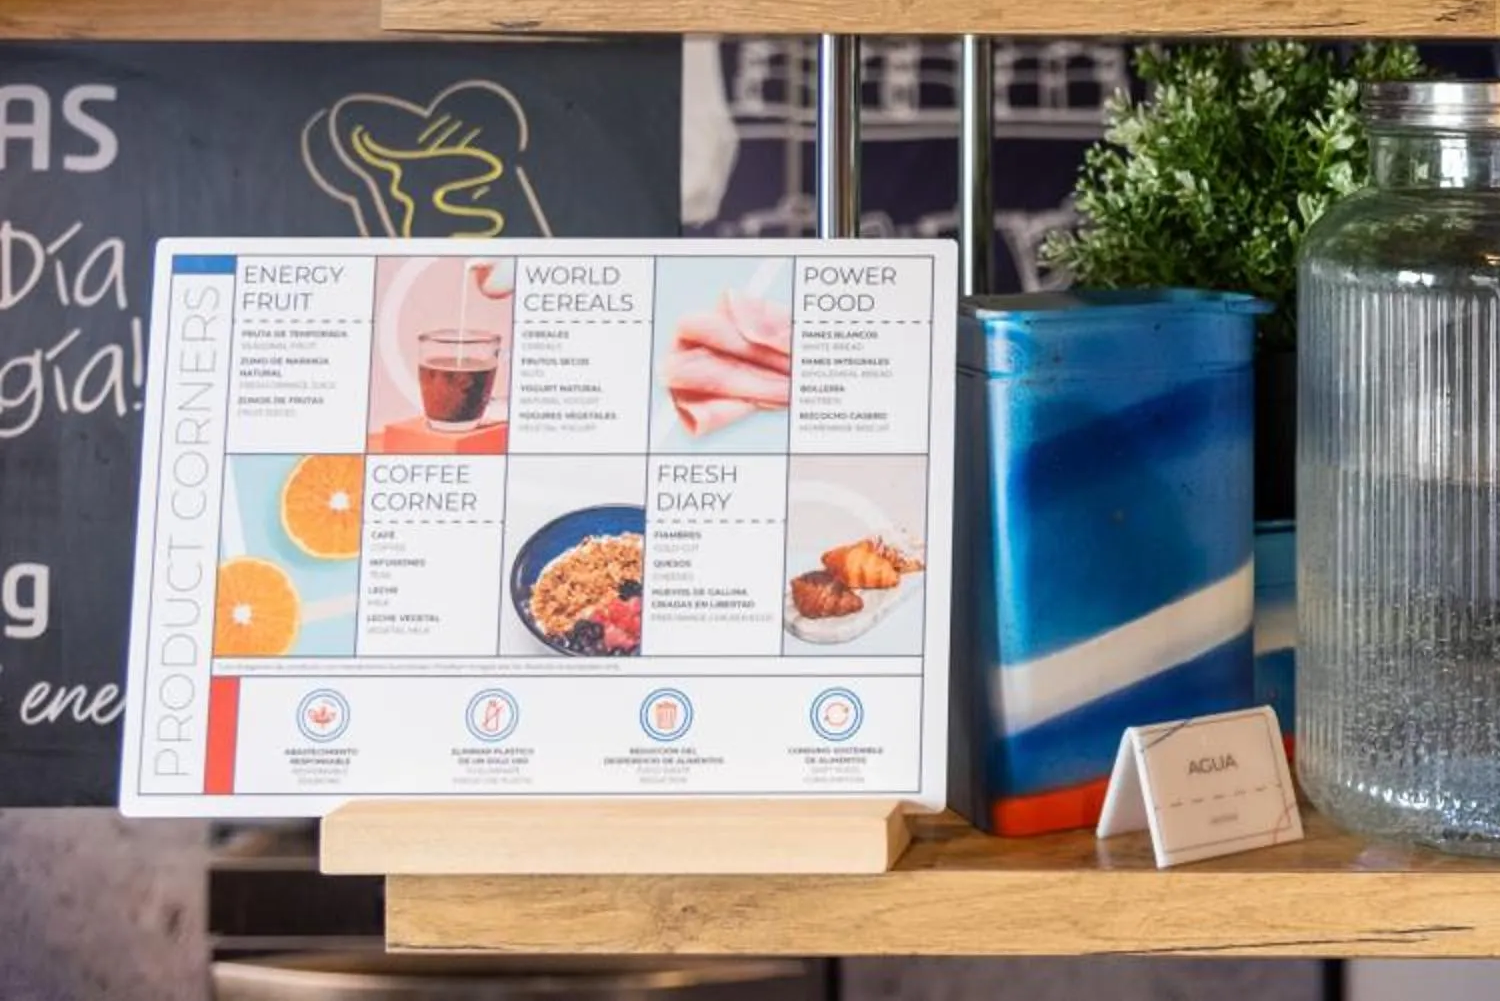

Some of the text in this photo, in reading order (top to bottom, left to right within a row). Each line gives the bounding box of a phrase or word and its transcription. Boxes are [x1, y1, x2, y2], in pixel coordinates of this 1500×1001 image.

[0, 84, 118, 171] AS
[0, 220, 128, 311] Día
[244, 265, 344, 285] ENERGY
[525, 265, 622, 286] WORLD
[804, 265, 898, 286] POWER
[242, 291, 314, 311] FRUIT
[523, 293, 634, 313] CEREALS
[802, 293, 876, 313] FOOD
[372, 465, 472, 484] COFFEE
[658, 465, 738, 484] FRESH
[370, 491, 478, 511] CORNER
[656, 491, 733, 511] DIARY
[153, 285, 220, 778] PRODUCT CORNERS
[1187, 753, 1239, 775] AGUA
